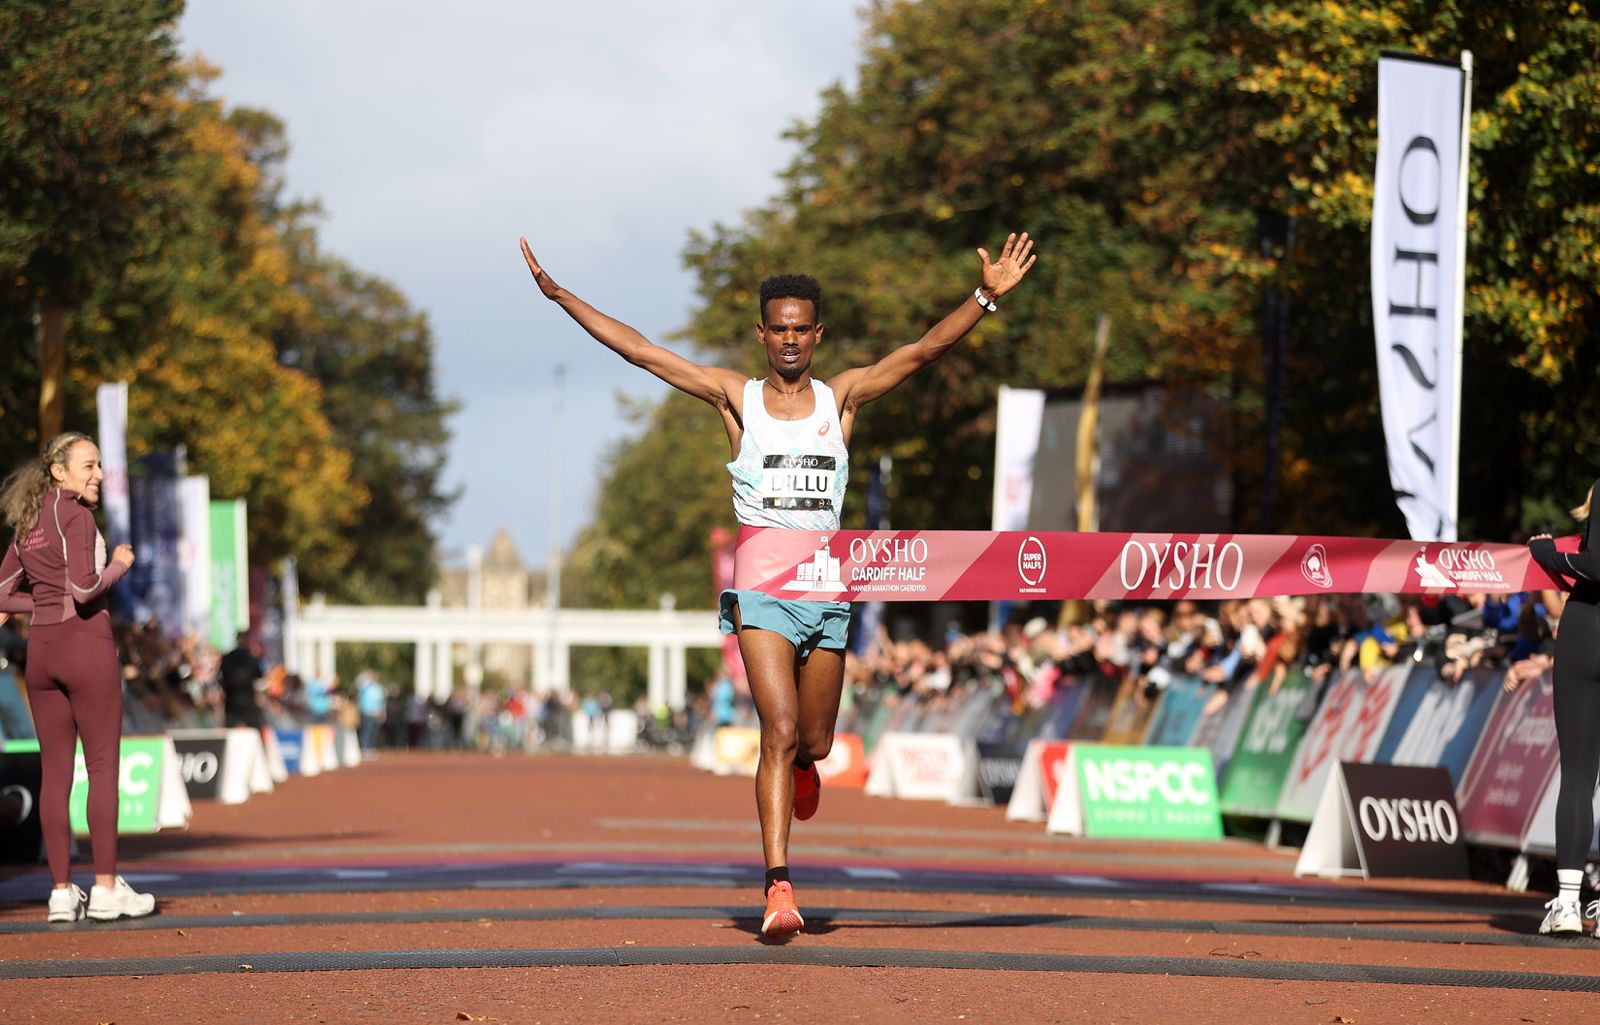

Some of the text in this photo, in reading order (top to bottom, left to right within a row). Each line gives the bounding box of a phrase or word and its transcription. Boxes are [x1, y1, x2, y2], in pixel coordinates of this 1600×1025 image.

[783, 457, 819, 467] OYSHO
[849, 537, 929, 564] OYSHO
[1023, 553, 1042, 561] SUPER
[1438, 548, 1495, 570] OYSHO
[851, 566, 926, 581] CARDIFF HALF
[1023, 561, 1042, 570] HALFS
[1120, 540, 1244, 592] OYSHO
[1083, 758, 1210, 805] NSPCC
[1359, 795, 1459, 845] OYSHO
